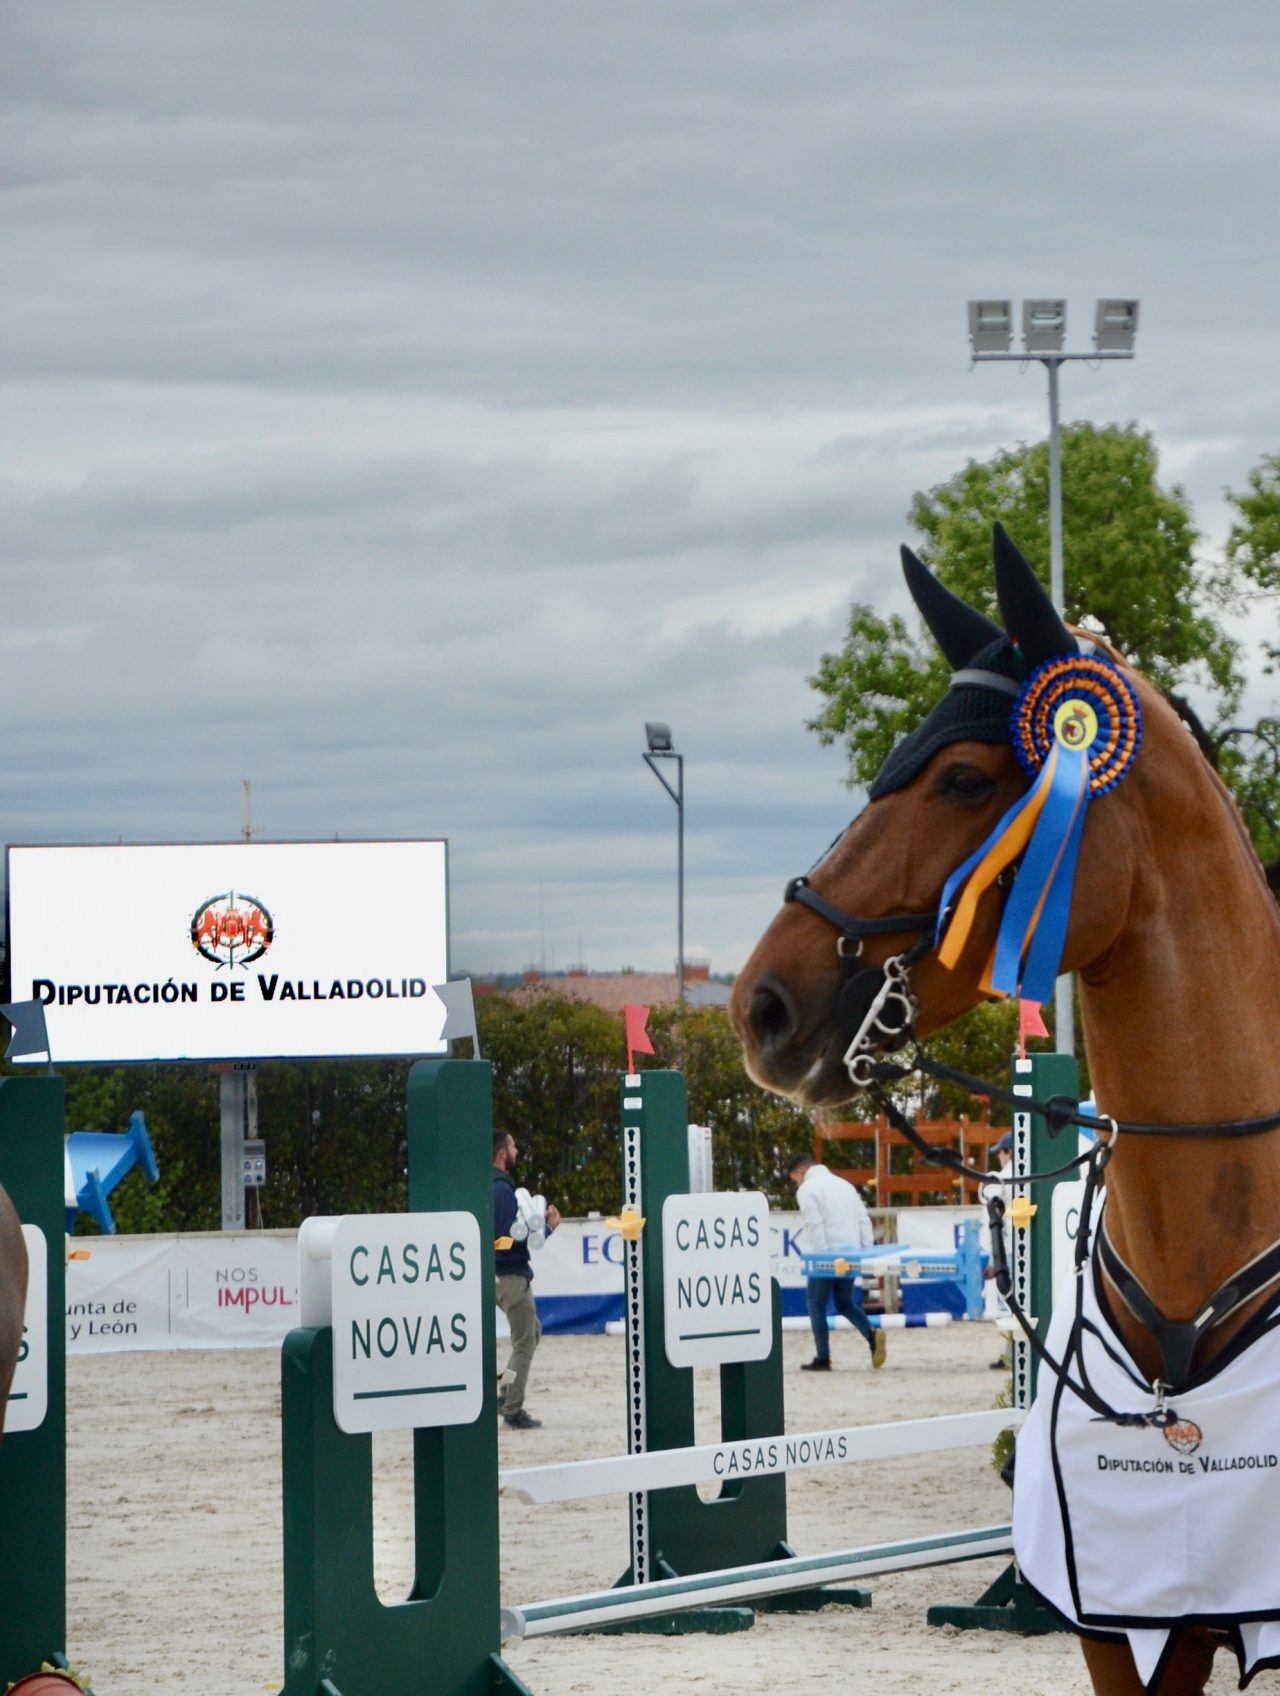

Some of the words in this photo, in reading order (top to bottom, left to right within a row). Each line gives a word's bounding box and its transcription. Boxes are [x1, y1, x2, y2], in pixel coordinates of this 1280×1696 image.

[32, 977, 198, 1005] DIPUTACIÓN
[211, 982, 246, 1001] DE
[257, 974, 427, 1001] VALLADOLID
[675, 1215, 759, 1251] CASAS
[216, 1267, 258, 1282] NOS
[350, 1241, 466, 1286] CASAS
[217, 1286, 298, 1314] IMPUL
[678, 1272, 761, 1309] NOVAS
[112, 1299, 137, 1314] de
[70, 1324, 82, 1340] y
[88, 1319, 137, 1335] León
[352, 1313, 468, 1360] NOVAS
[713, 1445, 778, 1475] CASAS
[786, 1436, 847, 1465] NOVAS
[1097, 1454, 1174, 1473] DIPUTACIÓN
[1179, 1461, 1195, 1474] DE
[1199, 1454, 1278, 1473] VALLADOLID
